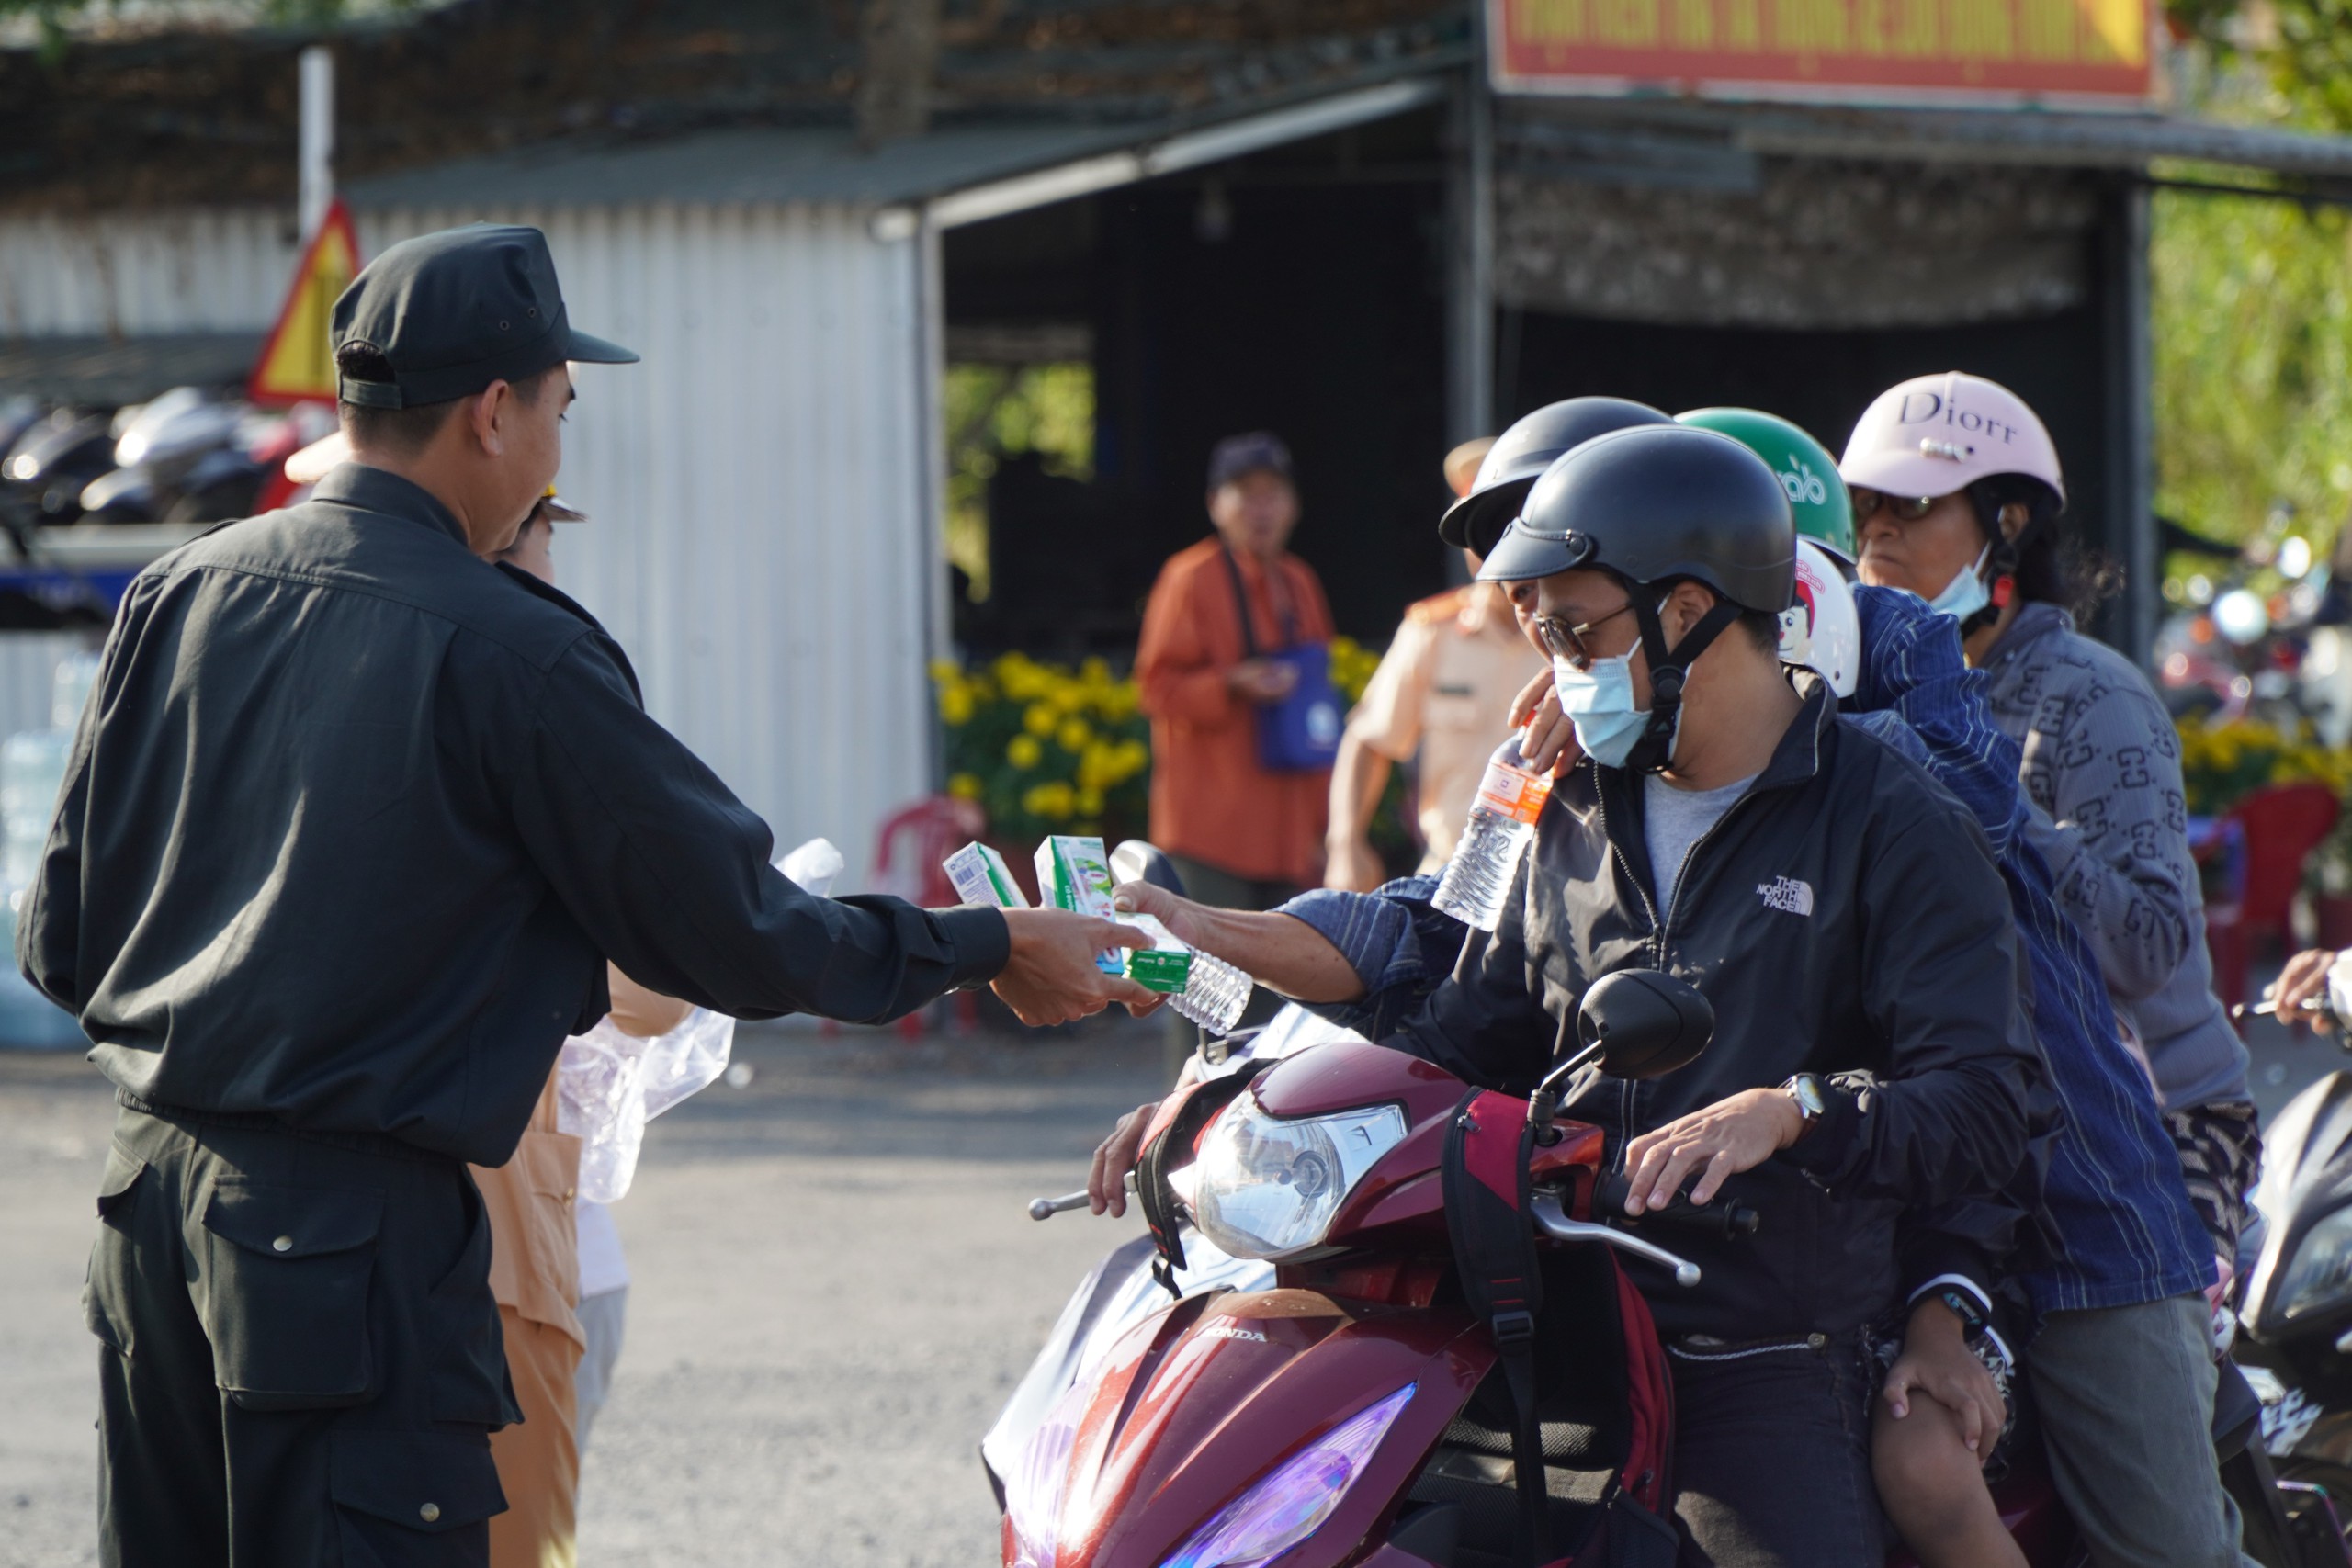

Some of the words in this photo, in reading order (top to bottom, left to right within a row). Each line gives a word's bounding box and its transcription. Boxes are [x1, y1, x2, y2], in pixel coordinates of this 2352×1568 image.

[1896, 392, 2018, 445] Diorr
[1777, 463, 1826, 505] ab
[1776, 875, 1801, 890] THE
[1756, 883, 1799, 903] NORTH
[1763, 895, 1796, 913] FACE
[1202, 1326, 1268, 1343] ONDA
